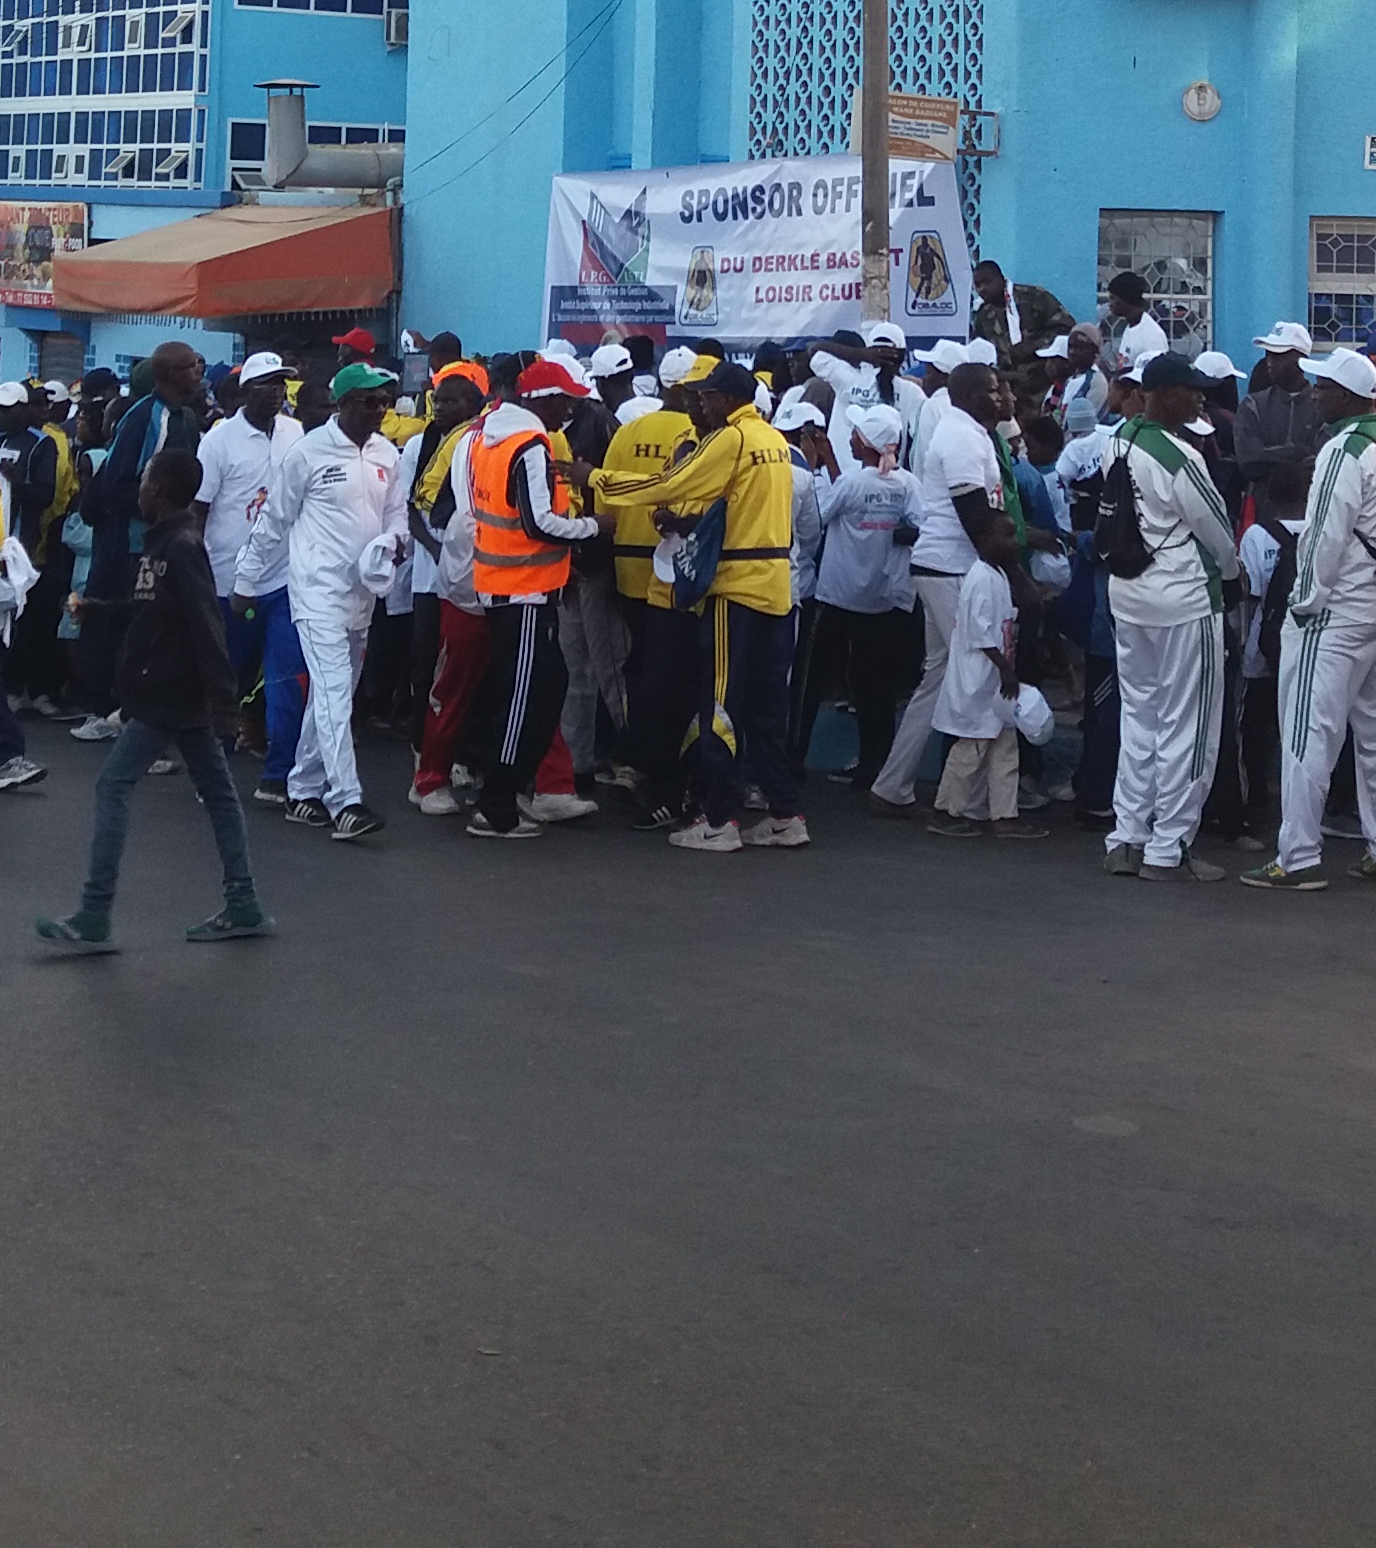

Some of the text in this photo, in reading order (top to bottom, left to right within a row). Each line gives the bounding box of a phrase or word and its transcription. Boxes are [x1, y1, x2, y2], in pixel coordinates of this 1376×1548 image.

[888, 98, 906, 106] ALON
[679, 169, 936, 224] SPONSOR OFFIEL
[720, 248, 904, 274] DU DERKLÉ BAST
[754, 284, 813, 303] LOISIR
[634, 443, 673, 459] HL
[750, 448, 791, 466] HLM
